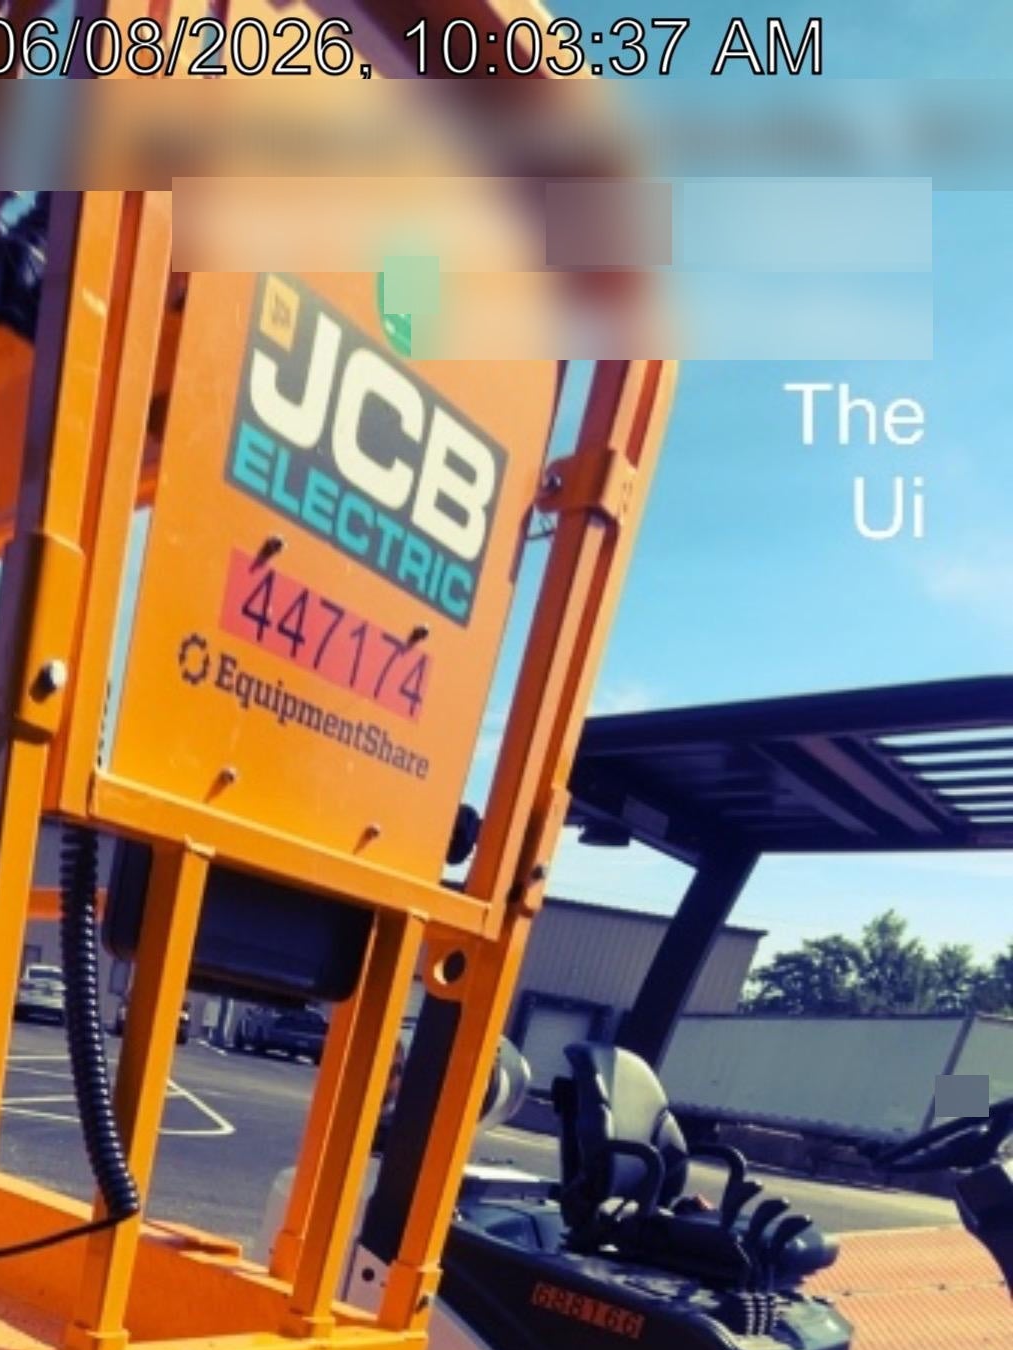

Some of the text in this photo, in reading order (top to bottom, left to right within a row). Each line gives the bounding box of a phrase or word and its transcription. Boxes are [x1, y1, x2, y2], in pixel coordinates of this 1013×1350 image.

[232, 420, 474, 620] ELECTRIC
[250, 312, 496, 561] JCB
[214, 652, 430, 780] EquipmentShare
[241, 569, 430, 717] 447174
